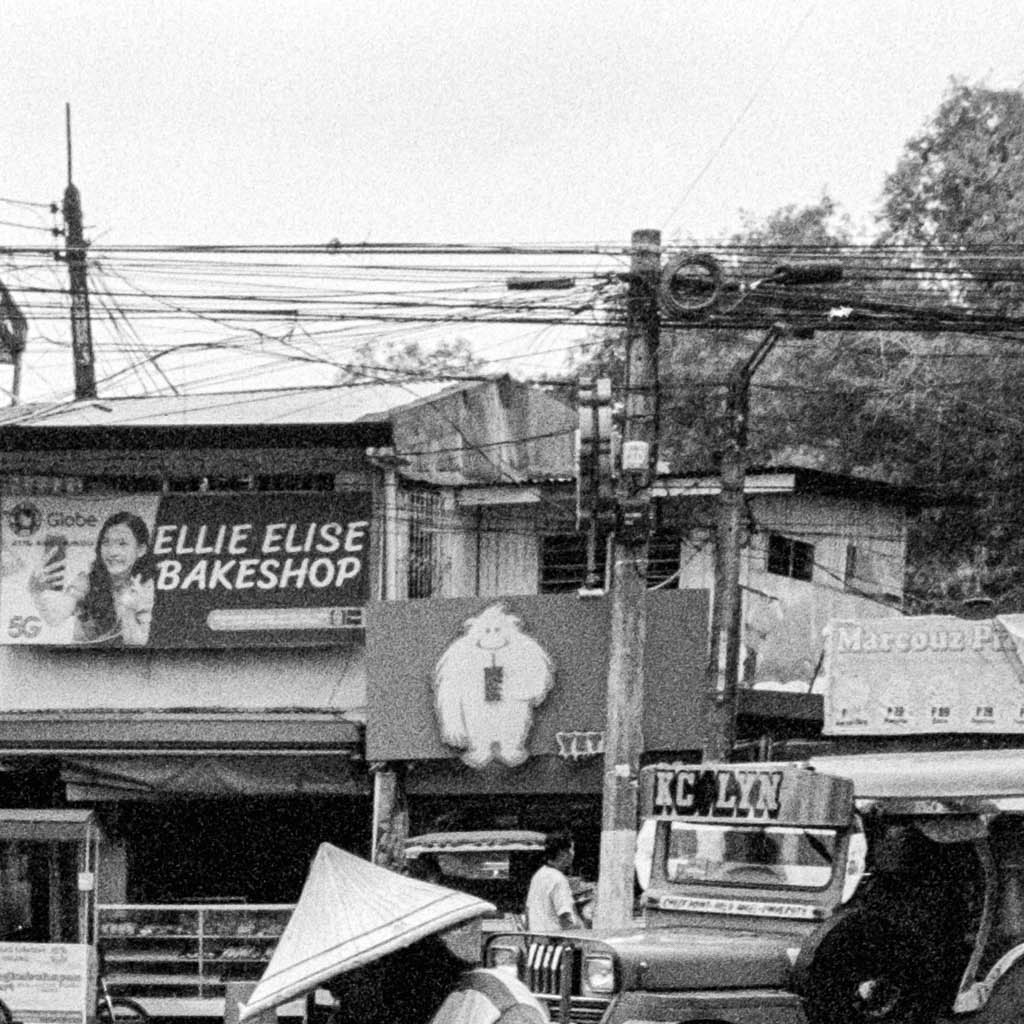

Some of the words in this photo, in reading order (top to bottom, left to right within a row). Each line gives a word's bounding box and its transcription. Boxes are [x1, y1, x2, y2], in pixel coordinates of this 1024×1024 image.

[47, 511, 97, 528] Globe
[153, 523, 252, 555] ELLIE
[260, 520, 369, 553] ELISE
[155, 556, 361, 591] BAKESHOP
[7, 615, 42, 639] 5G
[654, 769, 697, 811] KC
[716, 769, 783, 815] LYN
